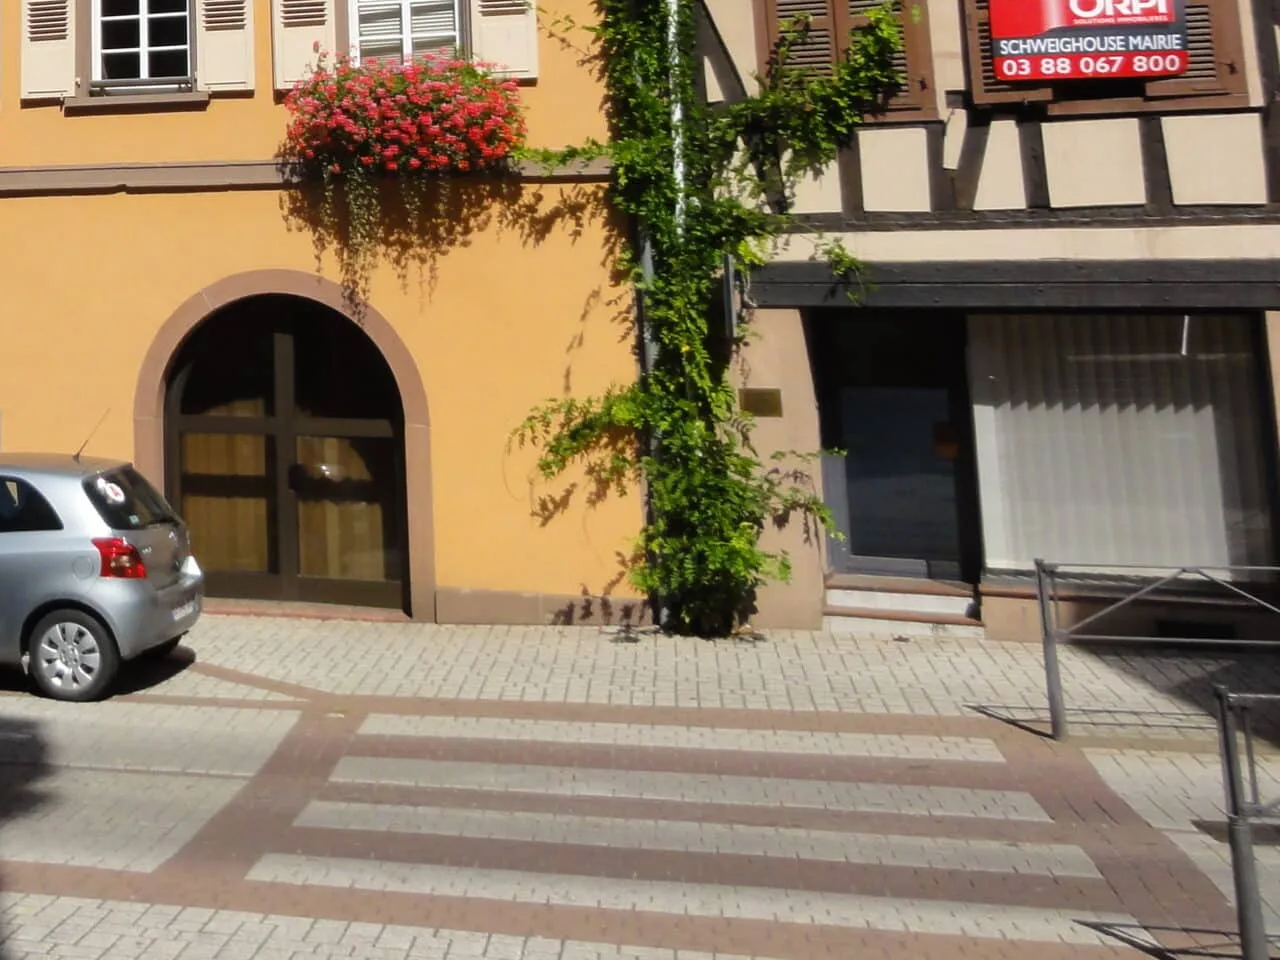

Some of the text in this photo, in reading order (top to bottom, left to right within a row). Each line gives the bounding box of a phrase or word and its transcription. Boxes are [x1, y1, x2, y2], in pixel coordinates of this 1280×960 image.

[1000, 34, 1182, 55] SCHWEIGHOUSE MAIRIE
[1002, 55, 1181, 76] 03 88 067 800
